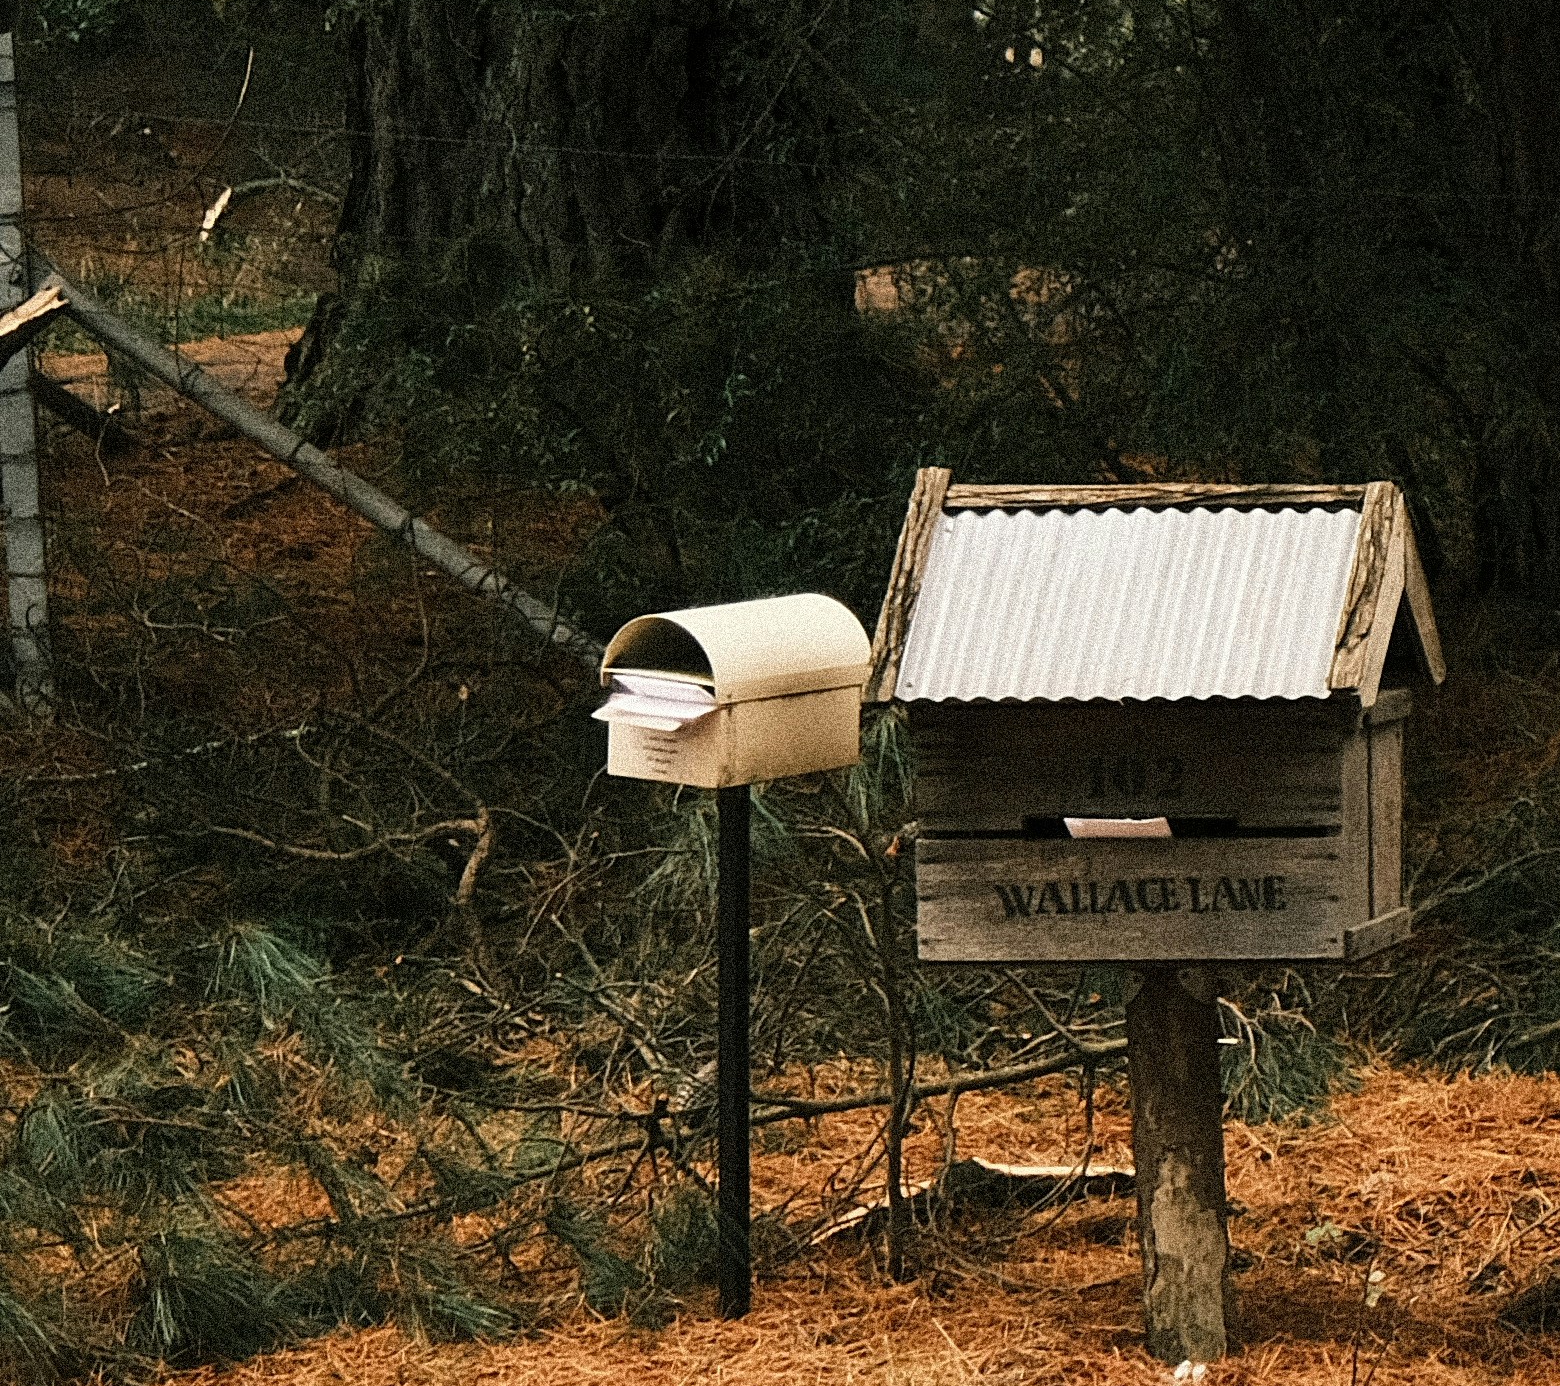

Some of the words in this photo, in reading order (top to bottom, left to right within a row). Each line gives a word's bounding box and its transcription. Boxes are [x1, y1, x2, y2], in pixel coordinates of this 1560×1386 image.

[1088, 756, 1184, 799] 102
[993, 876, 1181, 917] WALLACE
[1182, 875, 1286, 915] LANE
